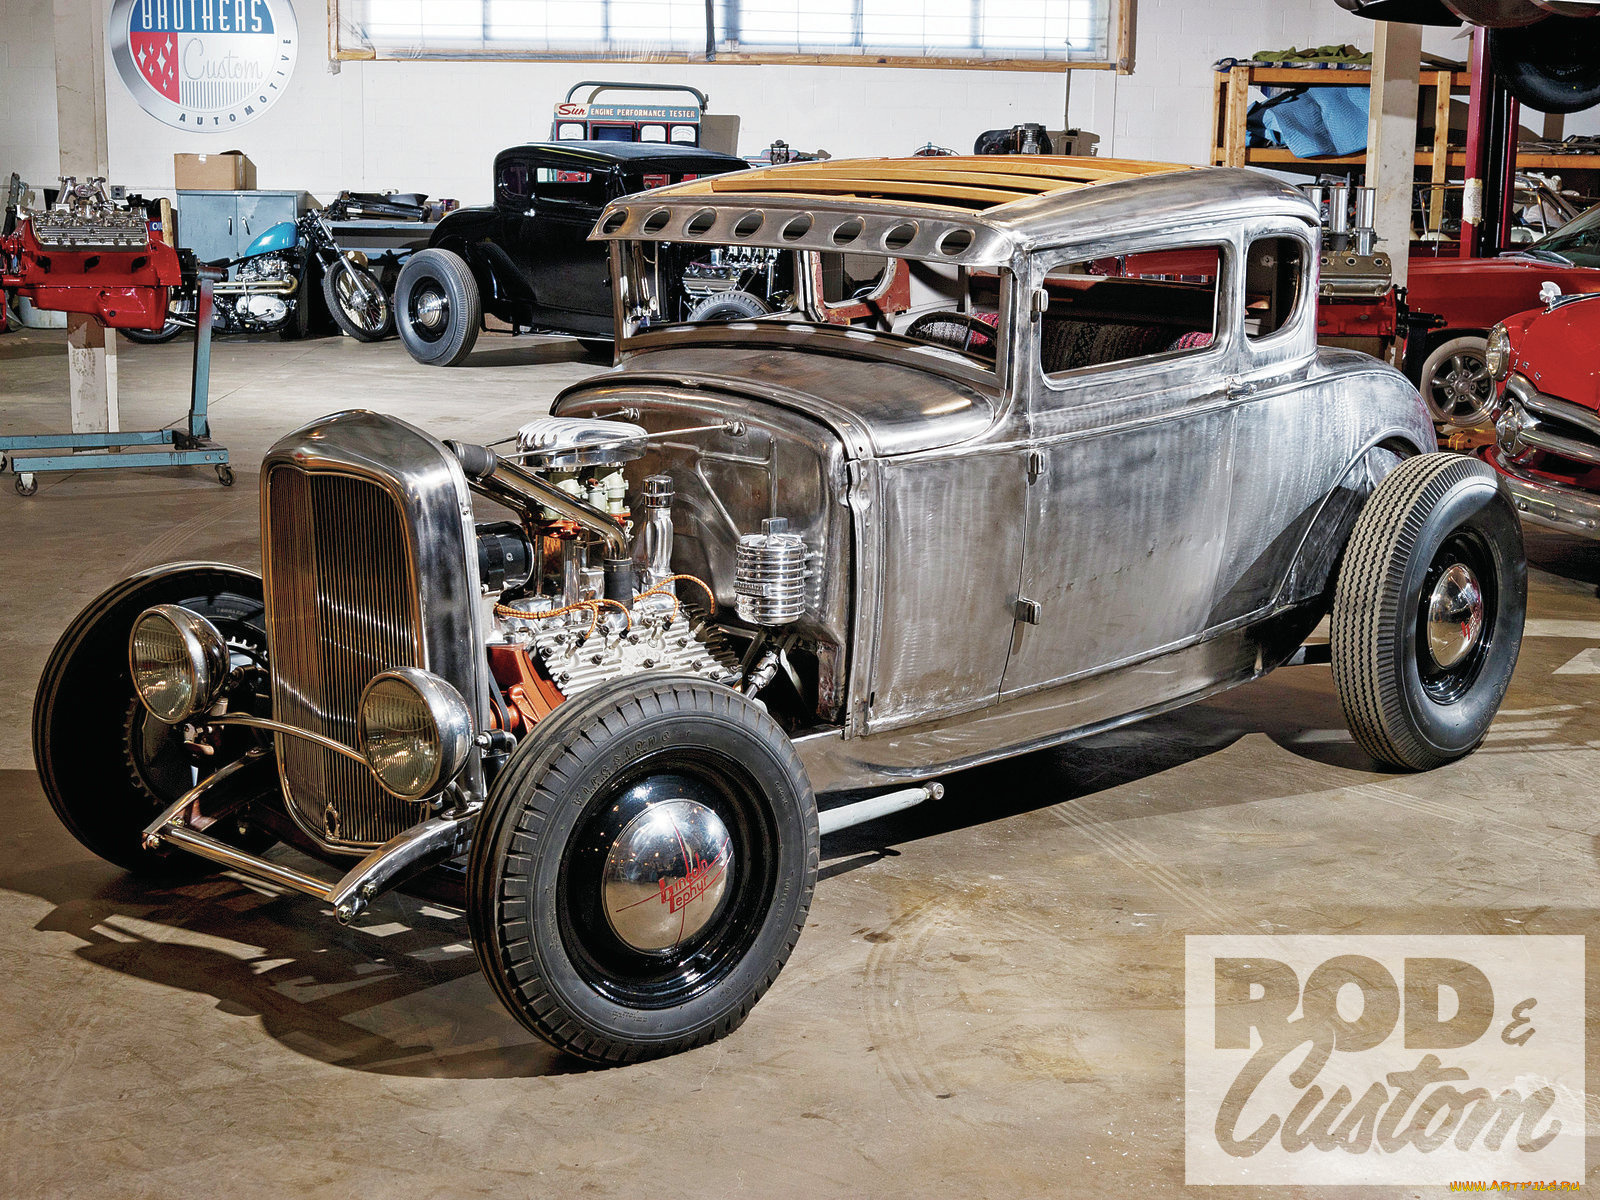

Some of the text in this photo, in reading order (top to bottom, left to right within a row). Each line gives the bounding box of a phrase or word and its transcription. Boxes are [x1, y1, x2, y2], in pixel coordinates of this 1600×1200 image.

[141, 0, 263, 32] BROTHERS
[183, 37, 263, 80] Custom
[178, 39, 292, 126] AUTOMOTIVE
[558, 103, 696, 119] Sun ENGINE PERFORMANCE TESTER
[659, 852, 708, 904] Lincoln
